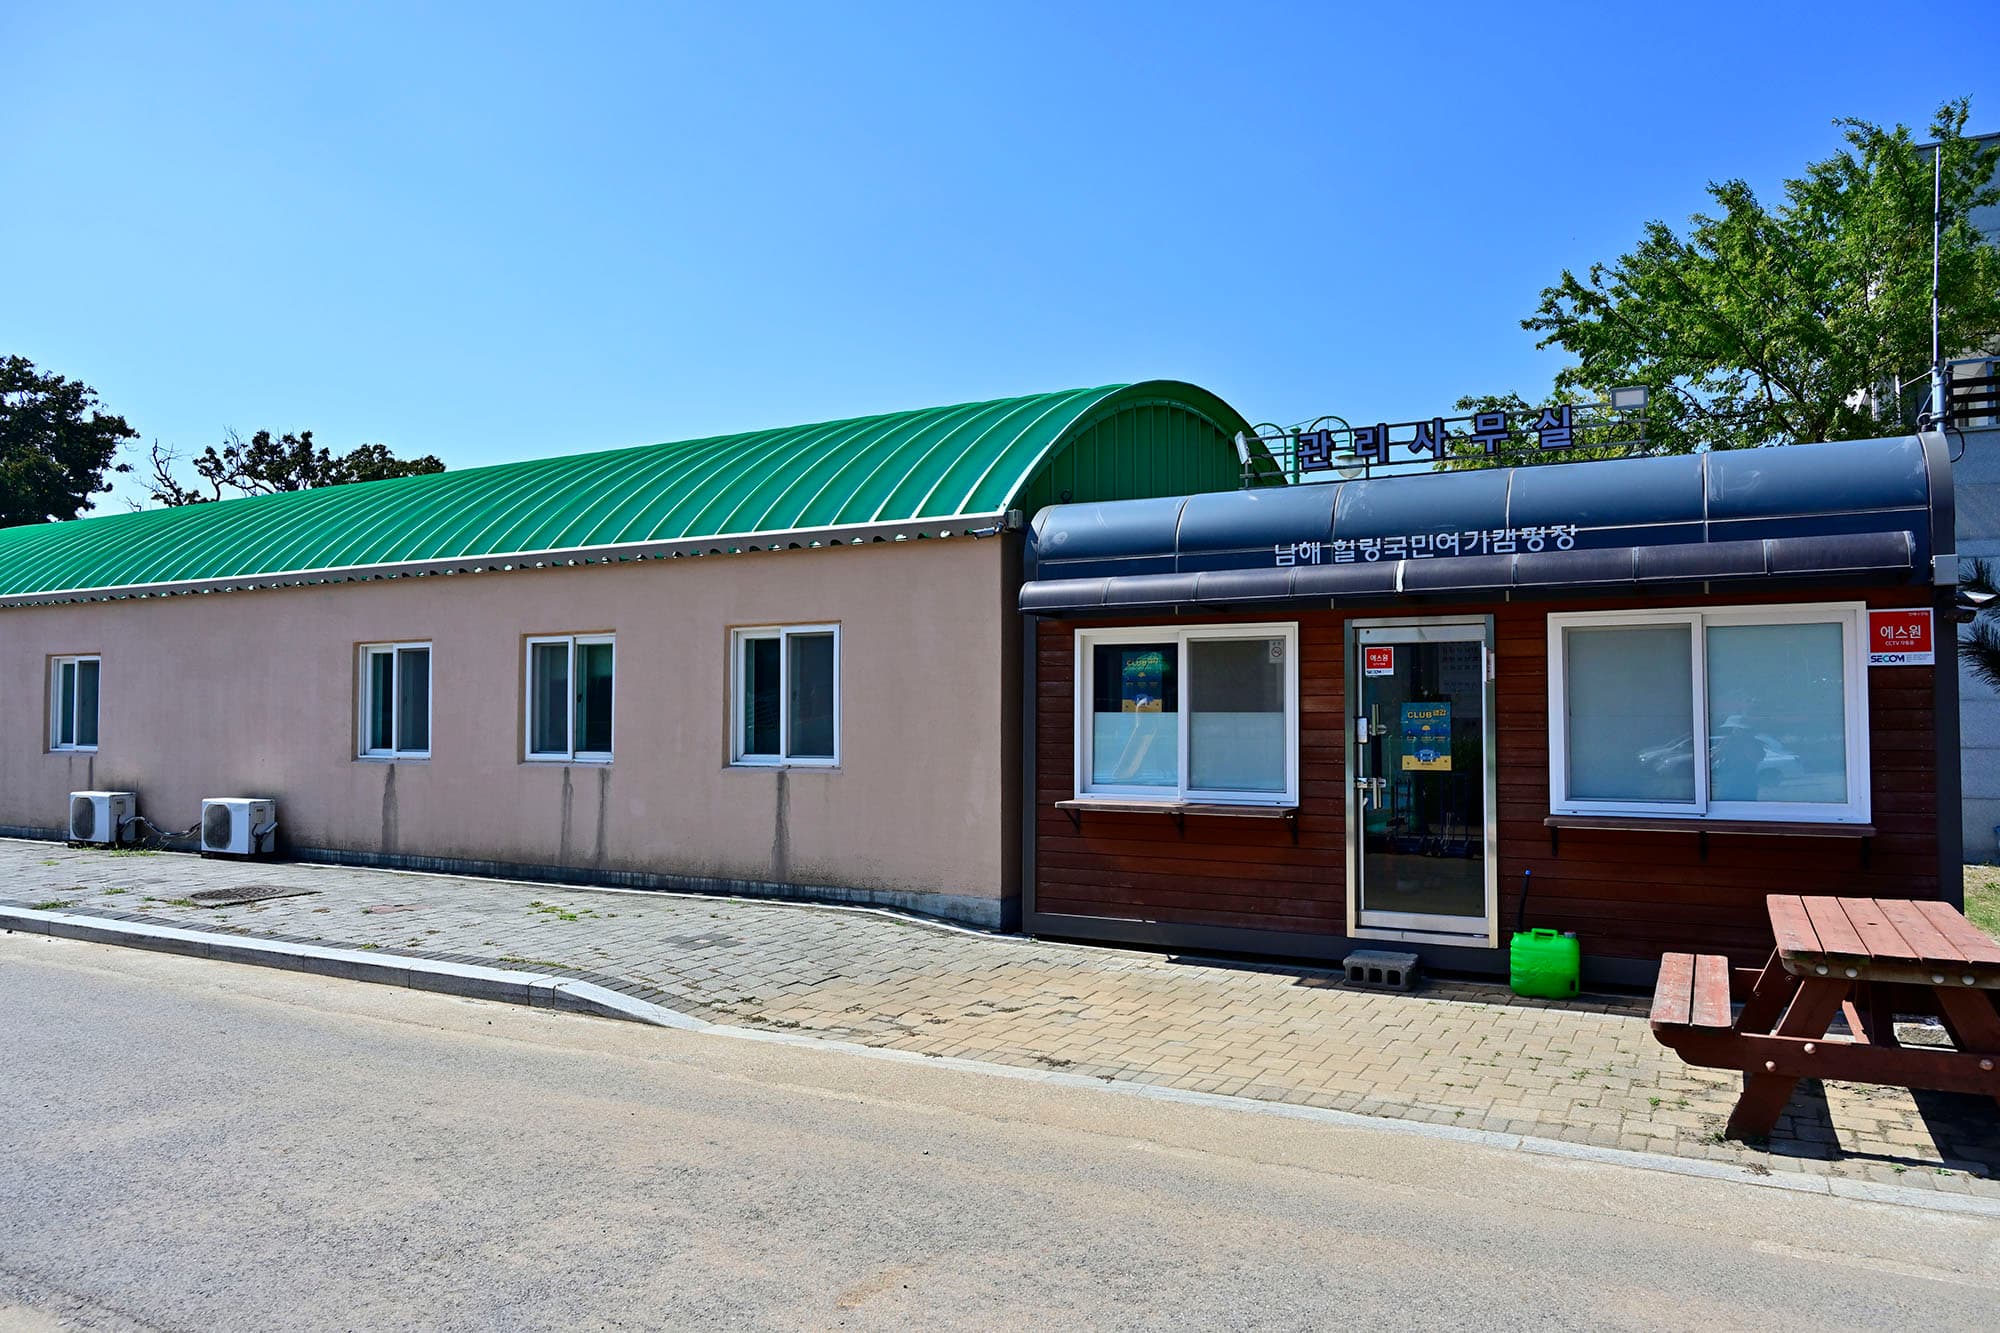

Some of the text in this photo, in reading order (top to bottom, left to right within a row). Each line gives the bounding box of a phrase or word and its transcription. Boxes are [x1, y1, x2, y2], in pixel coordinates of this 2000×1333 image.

[1297, 404, 1573, 472] 관리사무실
[1274, 541, 1321, 566] 남해
[1880, 625, 1921, 639] 에스원
[1870, 654, 1905, 663] SECOM
[1407, 711, 1433, 719] CLUB
